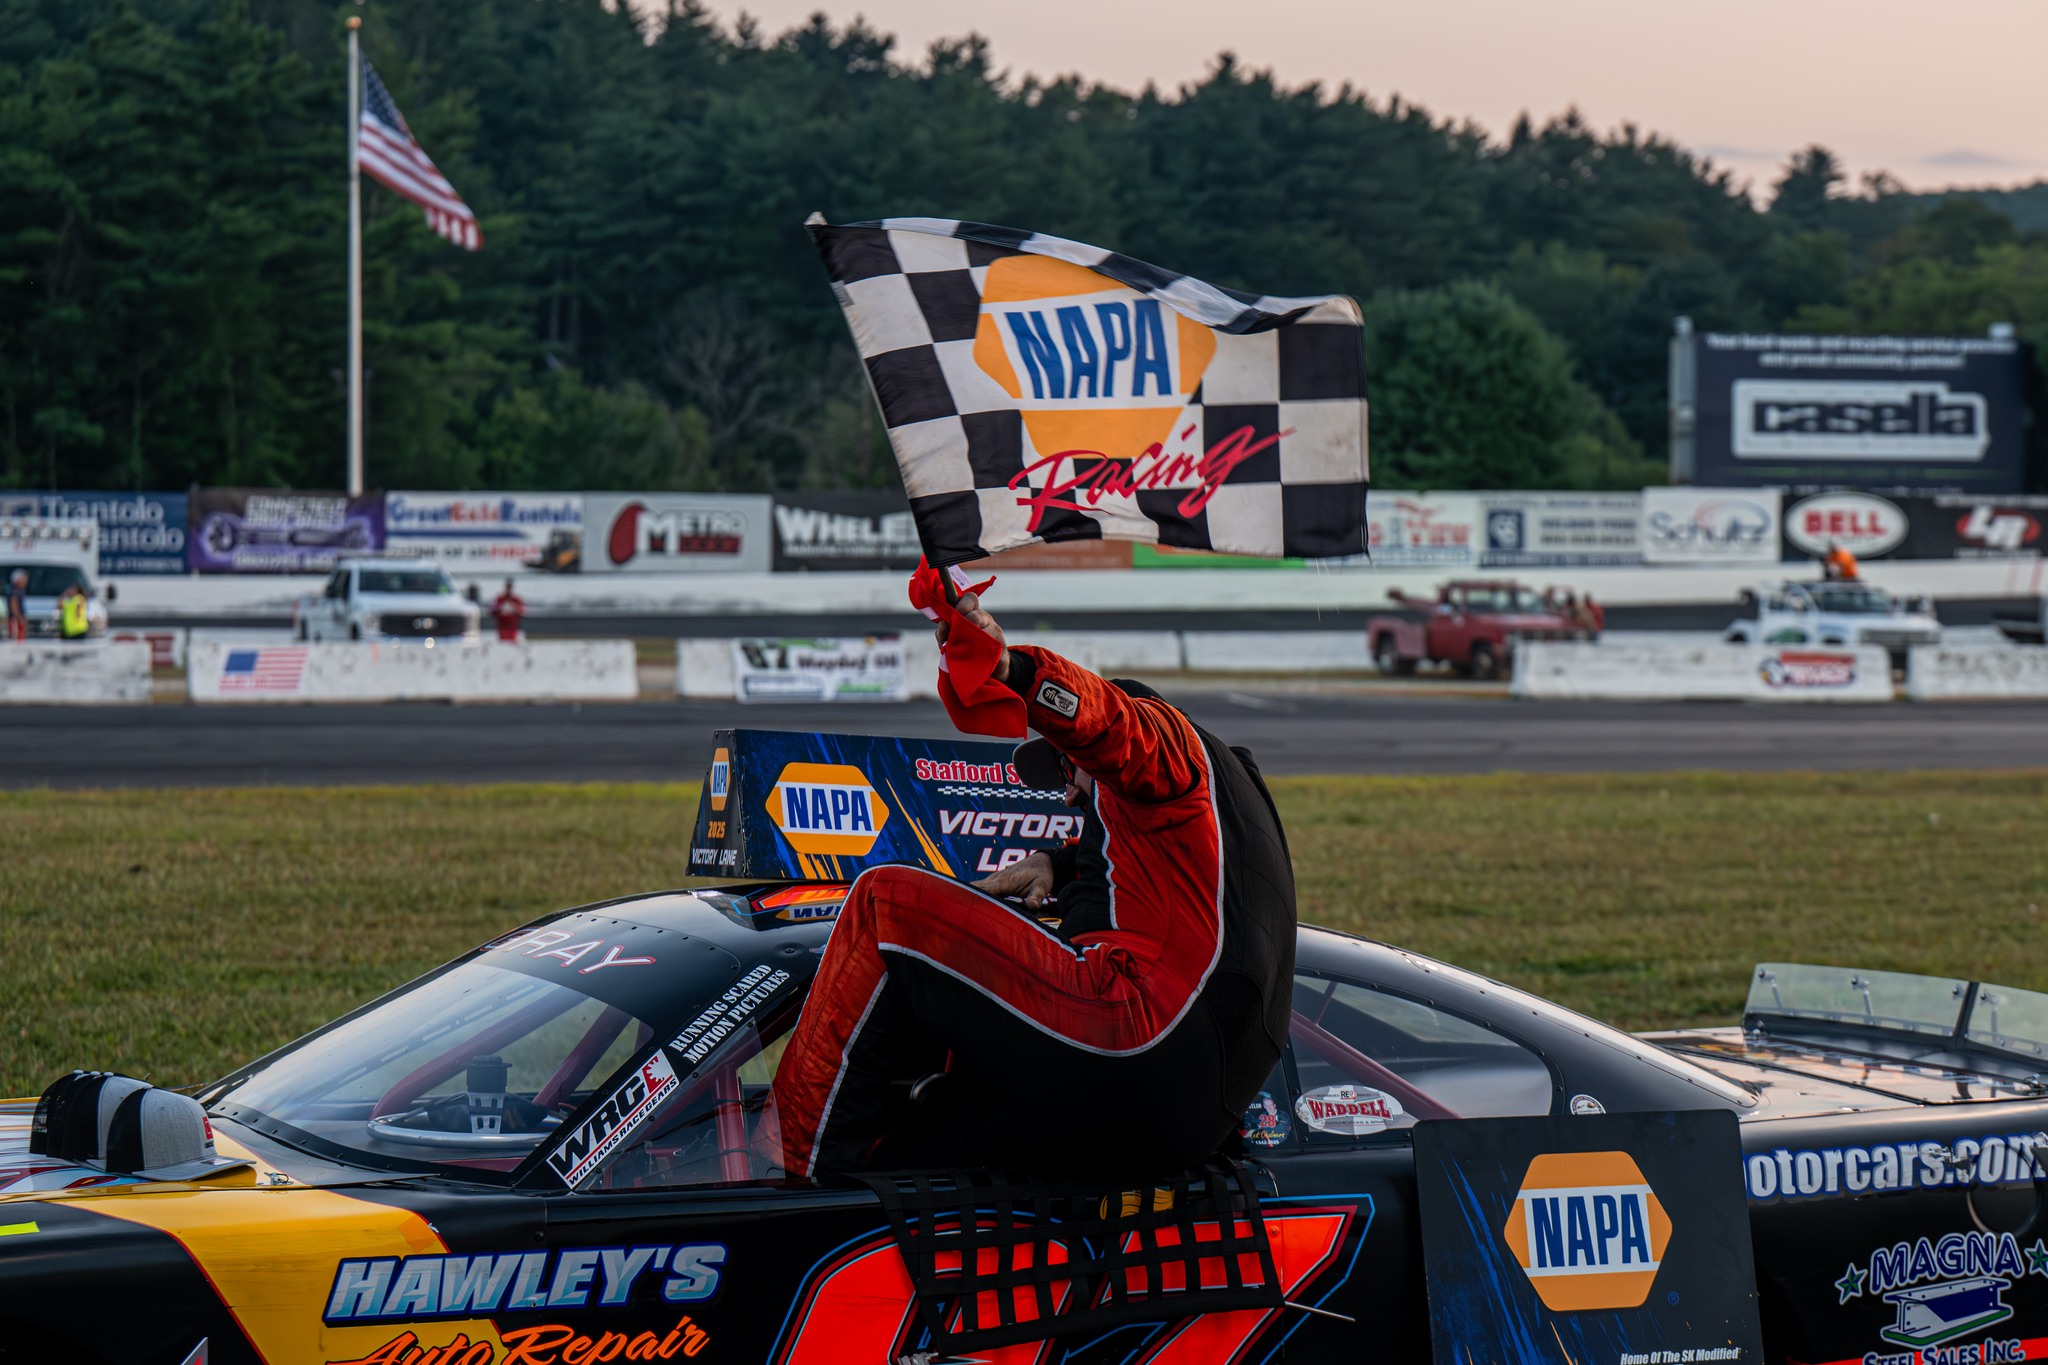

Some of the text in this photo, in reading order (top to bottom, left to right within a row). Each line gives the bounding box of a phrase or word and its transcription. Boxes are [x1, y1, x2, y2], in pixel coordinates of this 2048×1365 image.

[1005, 299, 1173, 400] NAPA
[1751, 393, 1977, 436] casella
[1008, 424, 1296, 532] Racing
[41, 495, 164, 527] Trantolo
[775, 505, 914, 543] WHELE
[1804, 509, 1887, 536] BELL
[98, 523, 185, 553] antolo
[635, 509, 749, 554] METRO
[713, 763, 728, 795] NAPA
[916, 758, 1004, 784] Stafford
[707, 821, 726, 838] 2025
[785, 787, 873, 832] NAPA
[939, 810, 1085, 839] VICTORY
[692, 849, 738, 866] VICTORY LANE
[976, 847, 1040, 872] LA
[480, 926, 658, 975] RAY
[669, 965, 772, 1052] RUNNING SCARED
[683, 969, 790, 1064] MOTION PICTURES
[1259, 1114, 1277, 1128] 28
[1307, 1099, 1392, 1120] WADDELL
[568, 1078, 678, 1186] WILLIAMS RACE GEARS
[1744, 1131, 2047, 1197] otorcars.com
[1531, 1193, 1651, 1268] NAPA
[325, 1243, 728, 1320] HAWLEY'S
[1870, 1231, 2024, 1294] MAGNA
[326, 1315, 711, 1365] Auto Repair
[1620, 1347, 1739, 1365] Home Of The SK Modified
[1984, 1337, 2026, 1364] INC.
